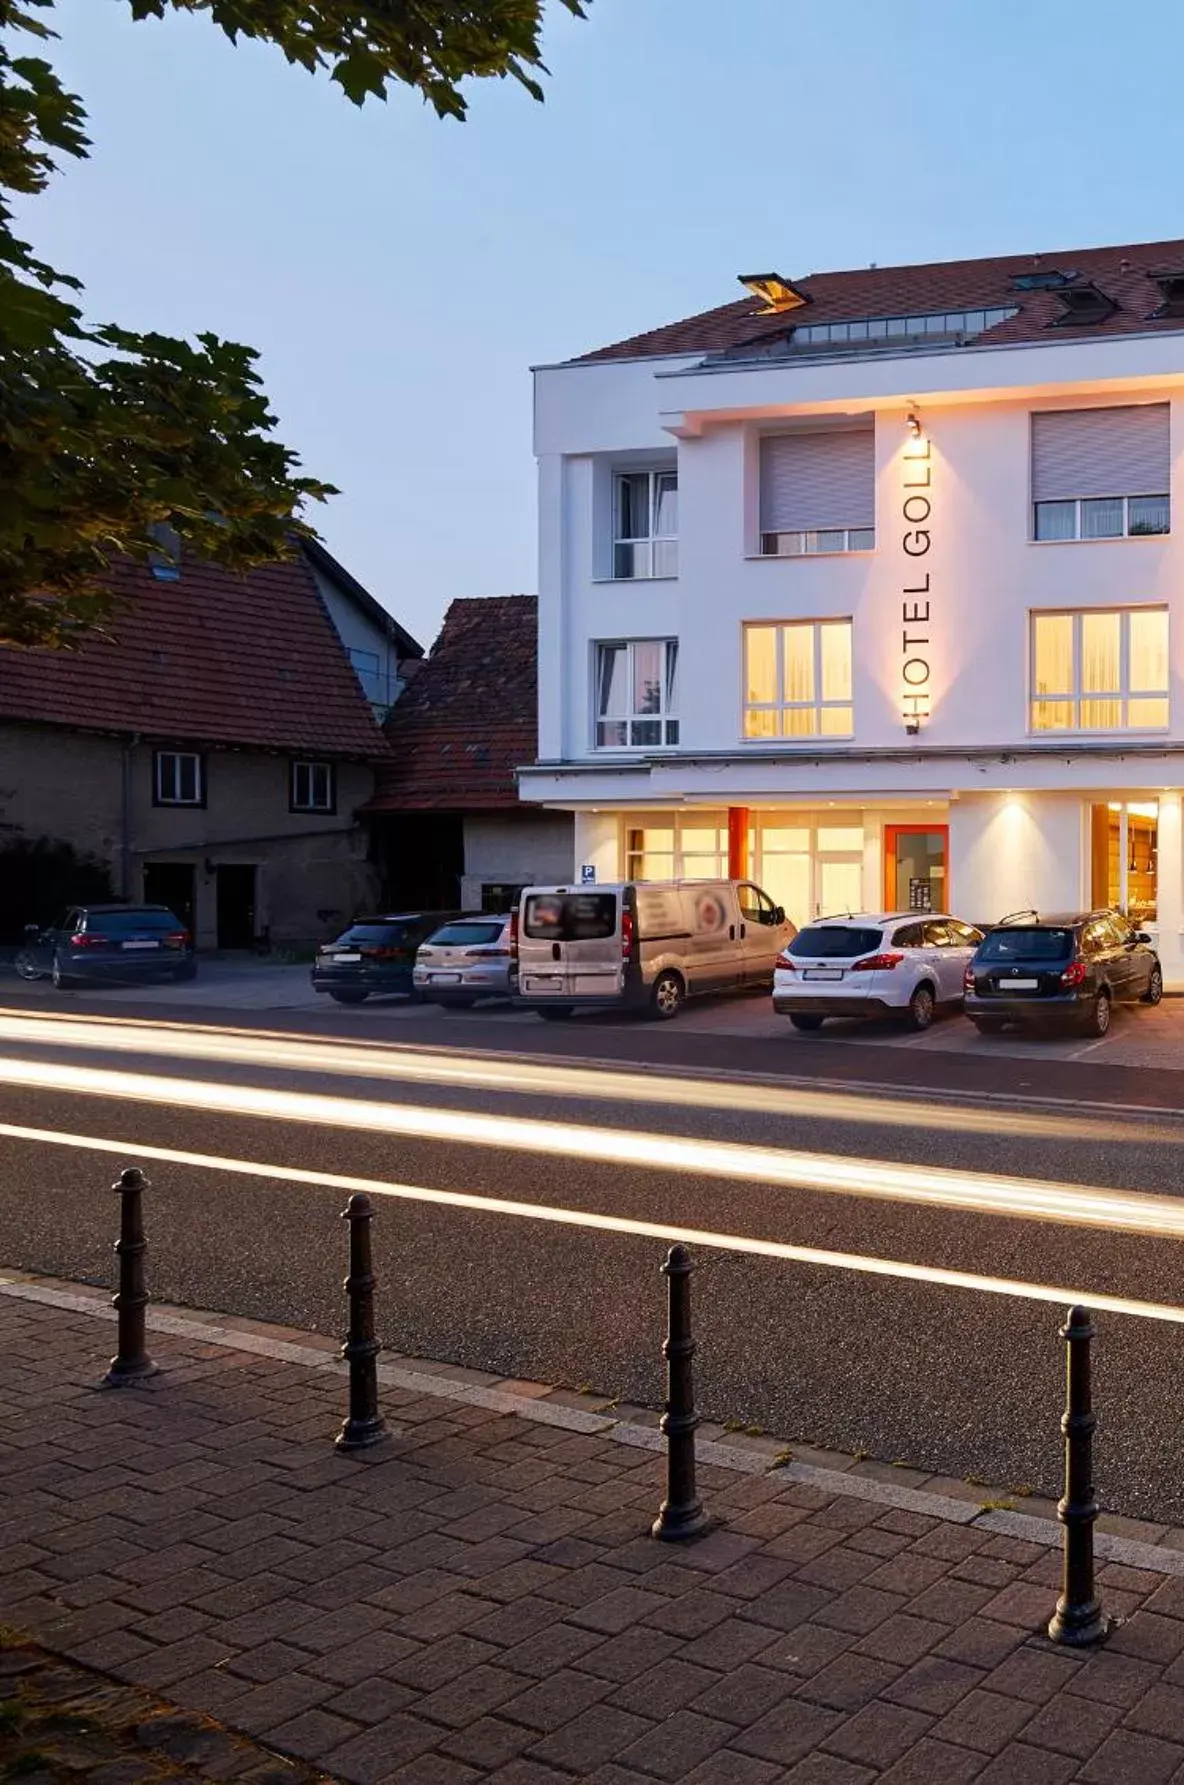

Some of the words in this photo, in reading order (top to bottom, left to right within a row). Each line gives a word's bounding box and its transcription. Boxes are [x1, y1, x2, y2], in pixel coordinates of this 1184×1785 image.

[902, 439, 931, 557] GOLL
[902, 573, 931, 719] HOTEL
[585, 866, 593, 876] P
